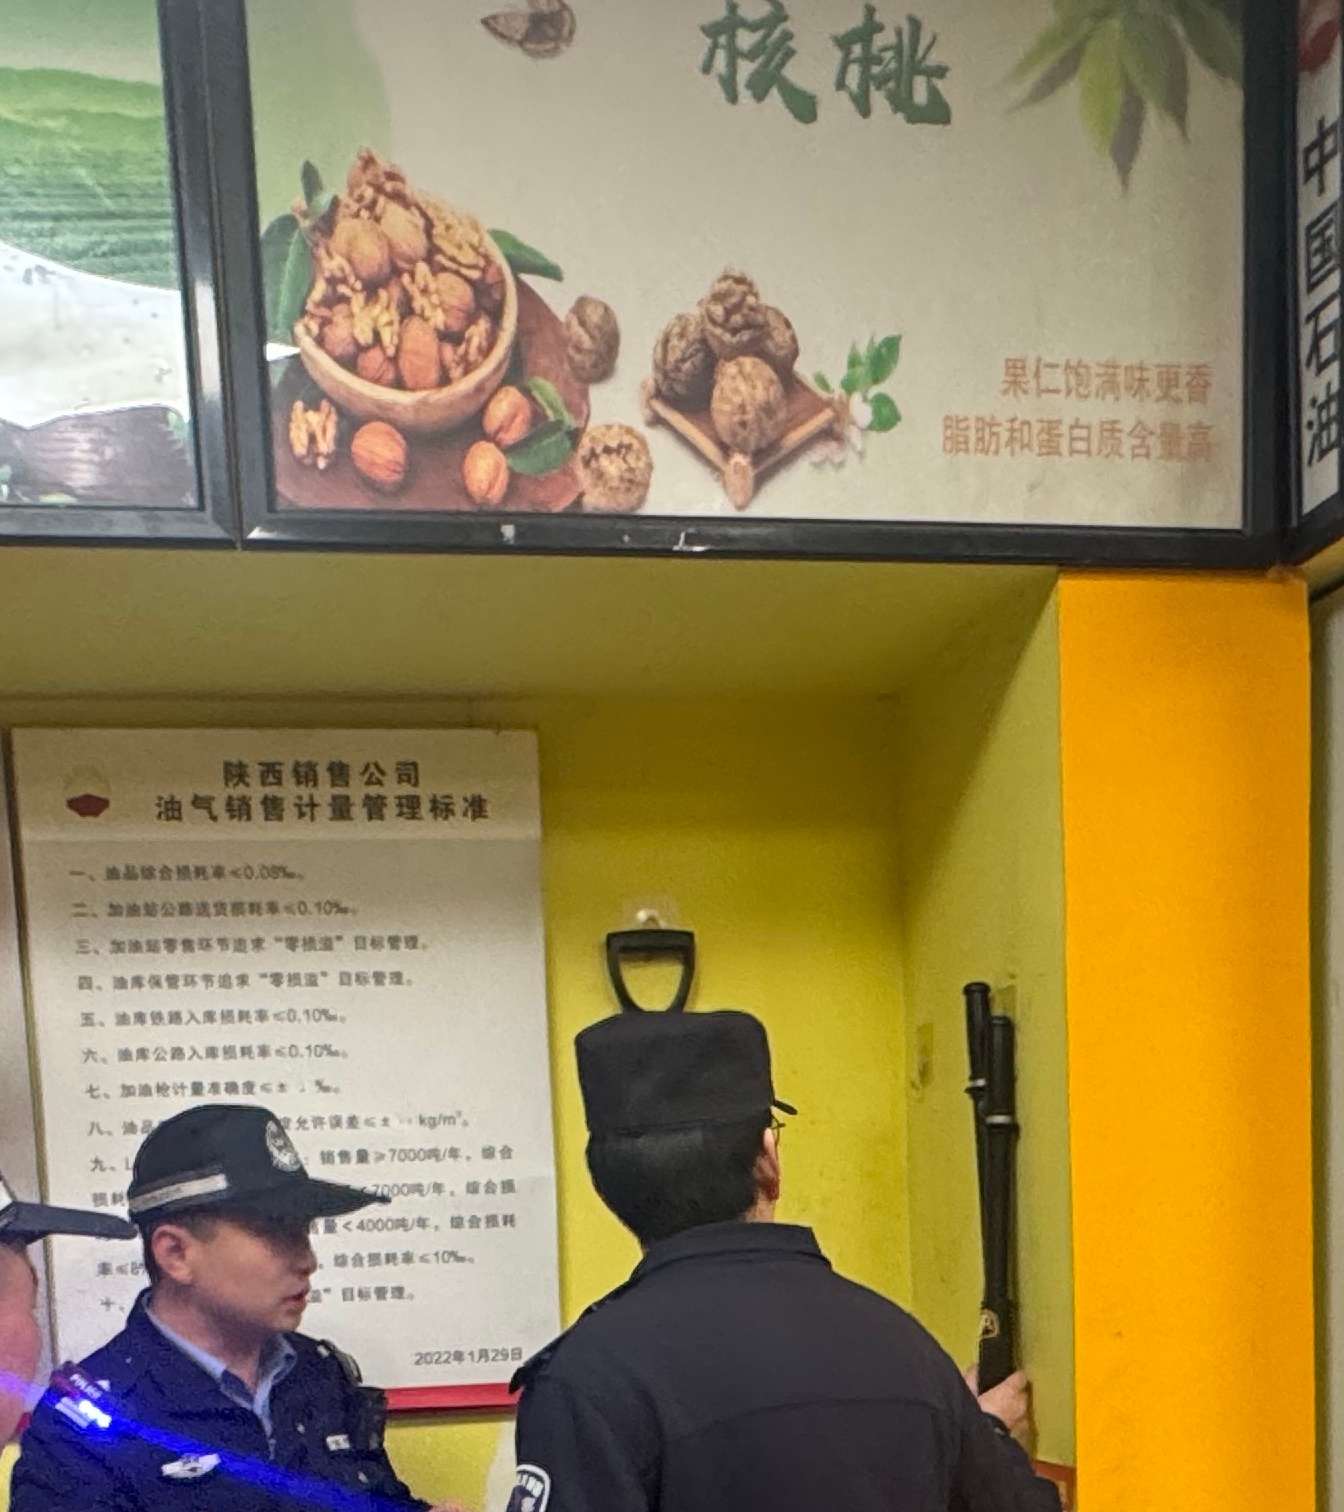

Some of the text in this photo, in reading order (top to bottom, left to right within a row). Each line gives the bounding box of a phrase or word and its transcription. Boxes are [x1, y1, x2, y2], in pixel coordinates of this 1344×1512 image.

[700, 0, 952, 125] 核桃
[1302, 115, 1340, 467] 中国石油
[1002, 357, 1214, 402] 果仁饱满味更香
[942, 414, 1215, 463] 脂肪和蛋白质含量高
[223, 760, 421, 788] 陕西销售公司
[156, 793, 490, 823] 油气销售计量管理标准
[414, 1347, 523, 1366] 2022年1月29日
